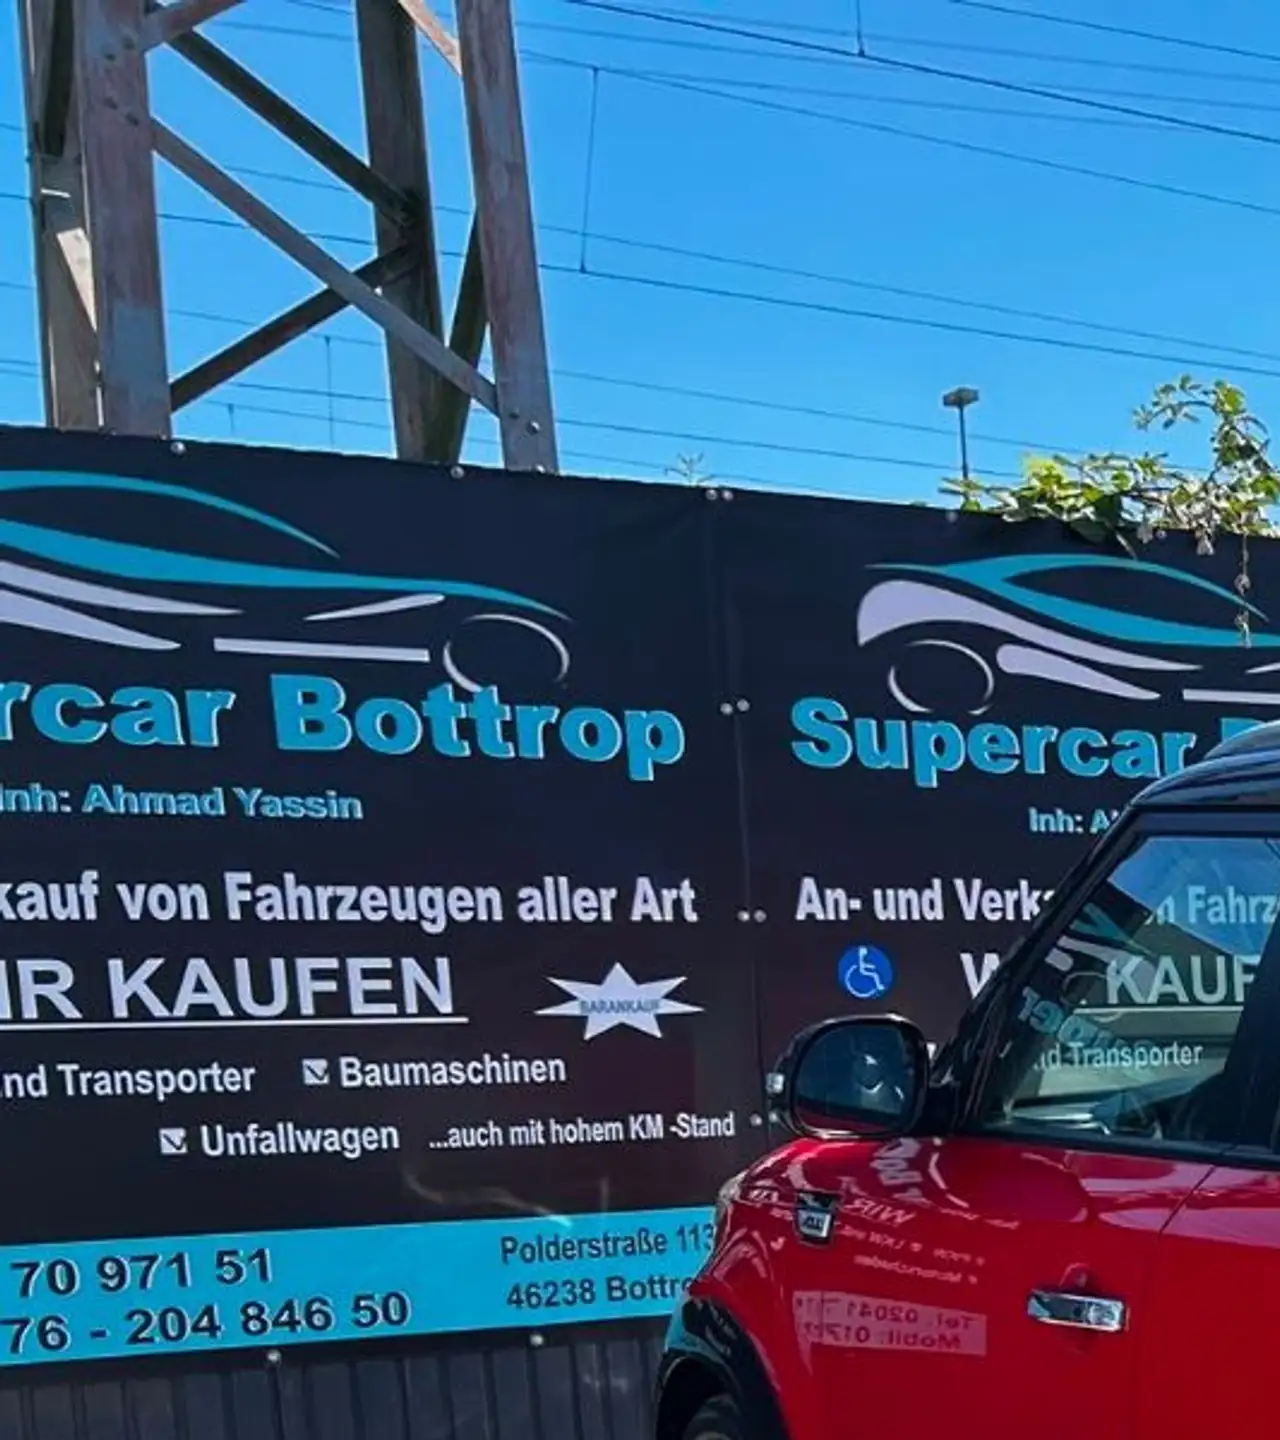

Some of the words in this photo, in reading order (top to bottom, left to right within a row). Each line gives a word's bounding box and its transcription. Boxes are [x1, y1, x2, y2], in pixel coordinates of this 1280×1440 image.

[270, 674, 686, 781] Bottrop
[790, 697, 1197, 787] Supercar
[82, 784, 226, 816] Ahmad
[234, 787, 363, 820] Yassin
[1028, 807, 1083, 834] Inh:
[116, 883, 210, 921] von
[224, 872, 502, 933] Fahrzeugen
[517, 876, 622, 922] aller
[630, 877, 698, 922] Art
[795, 876, 862, 921] An-
[873, 878, 944, 921] und
[953, 878, 1054, 921] Verk
[107, 955, 454, 1018] KAUFEN
[340, 1053, 566, 1088] Baumaschinen
[1068, 1041, 1203, 1069] Transporter
[0, 1063, 48, 1098] nd
[56, 1061, 256, 1102] Transporter
[201, 1122, 400, 1159] Unfallwagen
[509, 1118, 545, 1146] mit
[551, 1115, 624, 1145] hohem
[629, 1114, 664, 1140] KM
[669, 1111, 736, 1138] -Stand
[501, 1227, 668, 1265] Polderstraße
[11, 1258, 81, 1299] 70
[97, 1251, 192, 1293] 971
[215, 1247, 274, 1286] 51
[506, 1277, 596, 1310] 46238
[125, 1304, 223, 1345] 204
[240, 1295, 335, 1337] 846
[351, 1290, 411, 1329] 50
